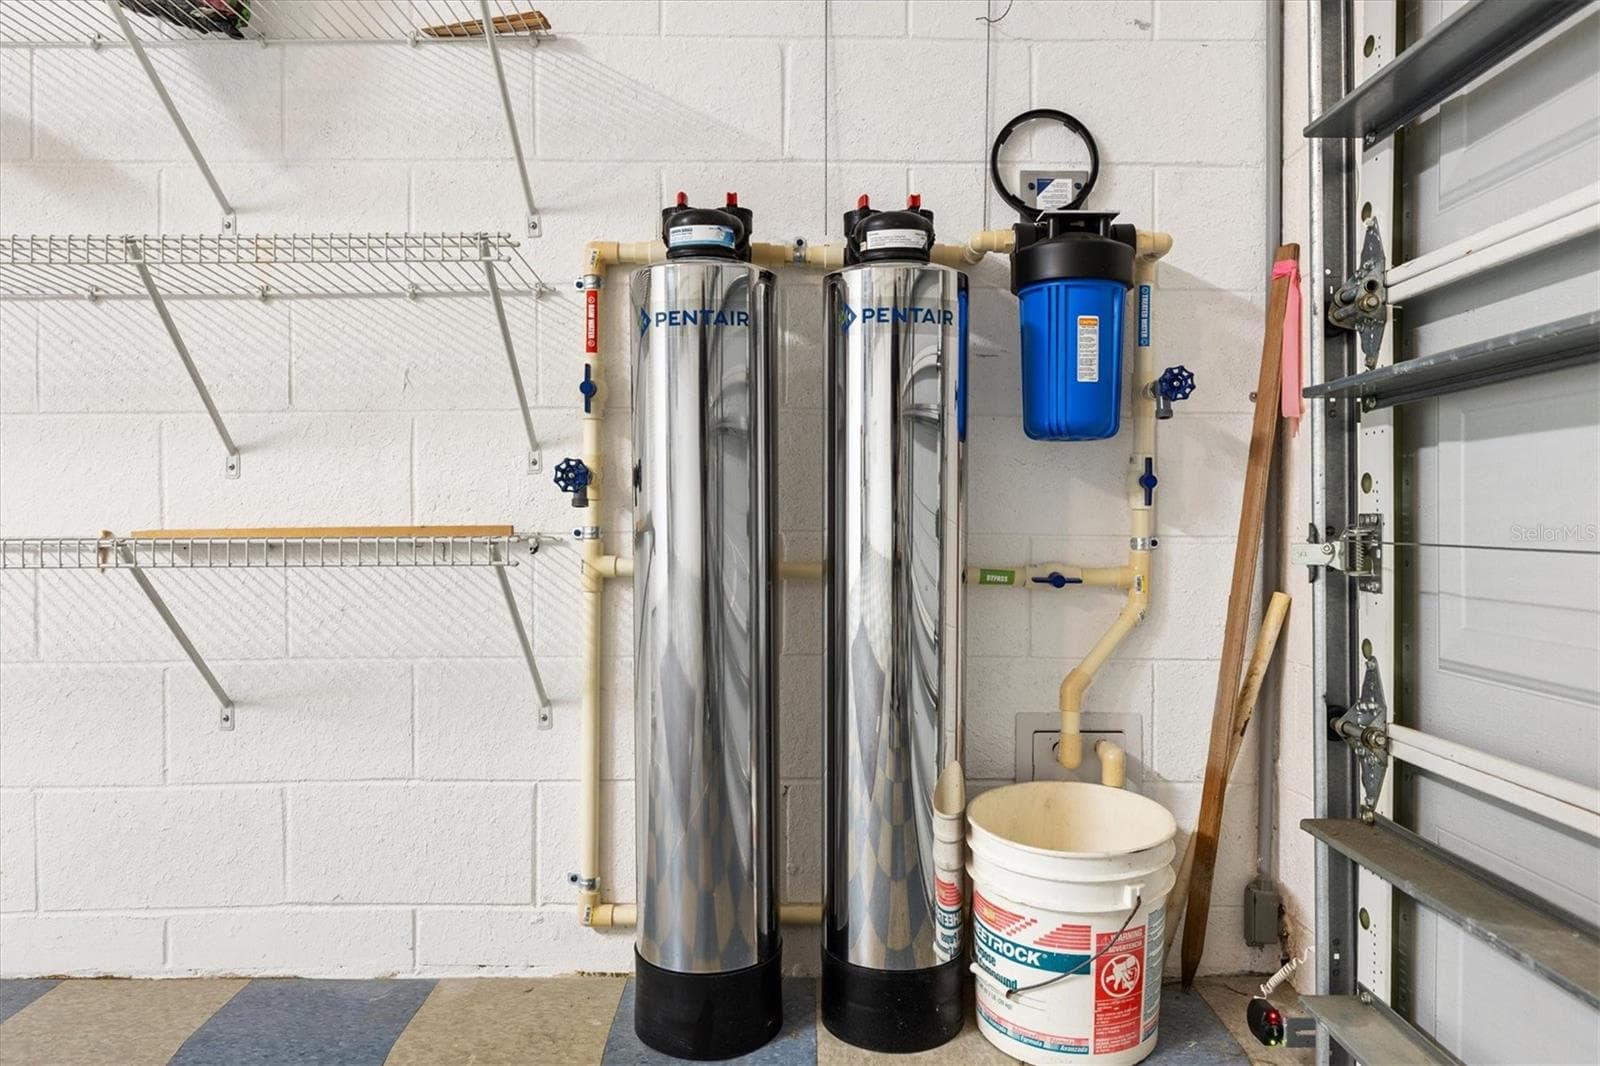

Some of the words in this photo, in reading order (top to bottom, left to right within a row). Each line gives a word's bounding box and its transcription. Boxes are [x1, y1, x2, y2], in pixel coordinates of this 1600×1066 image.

[655, 310, 749, 328] PENTAIR
[862, 307, 953, 325] PENTAIR
[587, 319, 596, 339] WATER
[1140, 319, 1148, 338] WATER
[986, 574, 1008, 583] BYPASS
